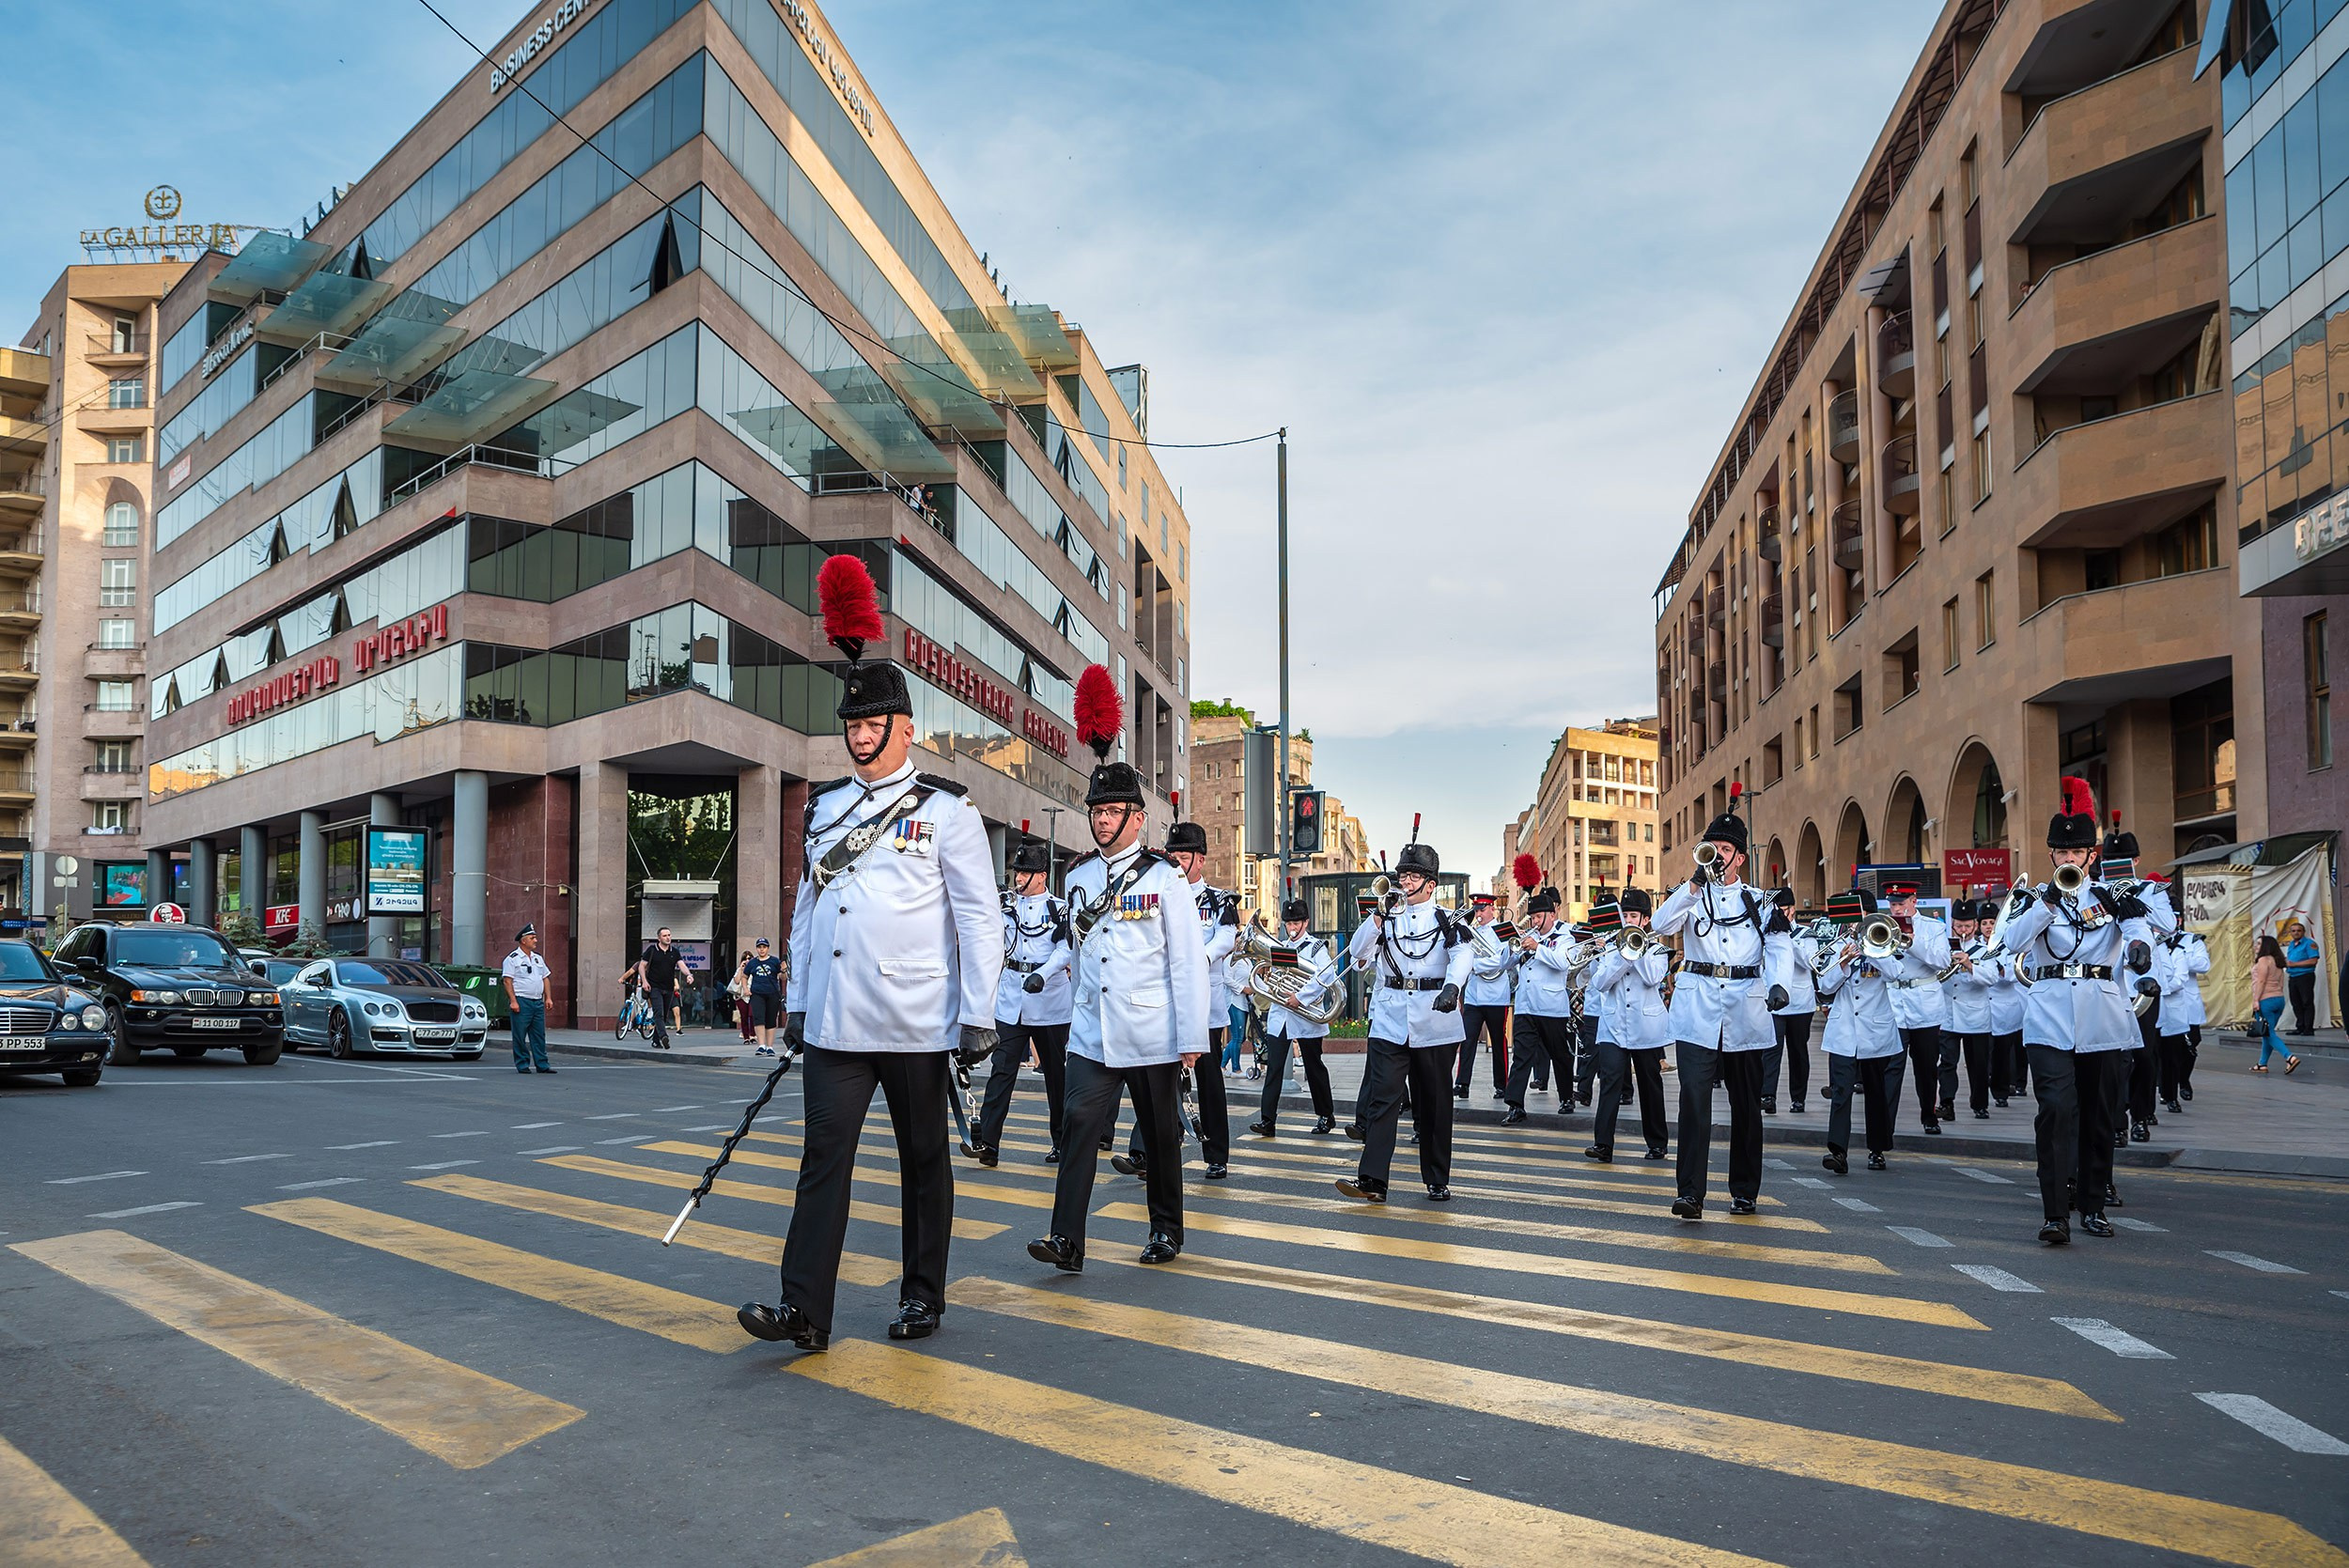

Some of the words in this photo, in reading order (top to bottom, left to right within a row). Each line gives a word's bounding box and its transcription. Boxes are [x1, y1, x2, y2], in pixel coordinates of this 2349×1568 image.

[490, 18, 552, 94] BUSINESS
[103, 224, 236, 247] GALLERIA
[353, 603, 447, 673] ԱՐՄԵՆԻԱ
[905, 628, 1014, 722] ROSGOSSTRAKH
[1023, 708, 1068, 757] ARMENIA
[274, 908, 291, 924] KFC
[225, 1019, 238, 1028] 117
[7, 1038, 22, 1048] PP
[23, 1038, 42, 1048] 553
